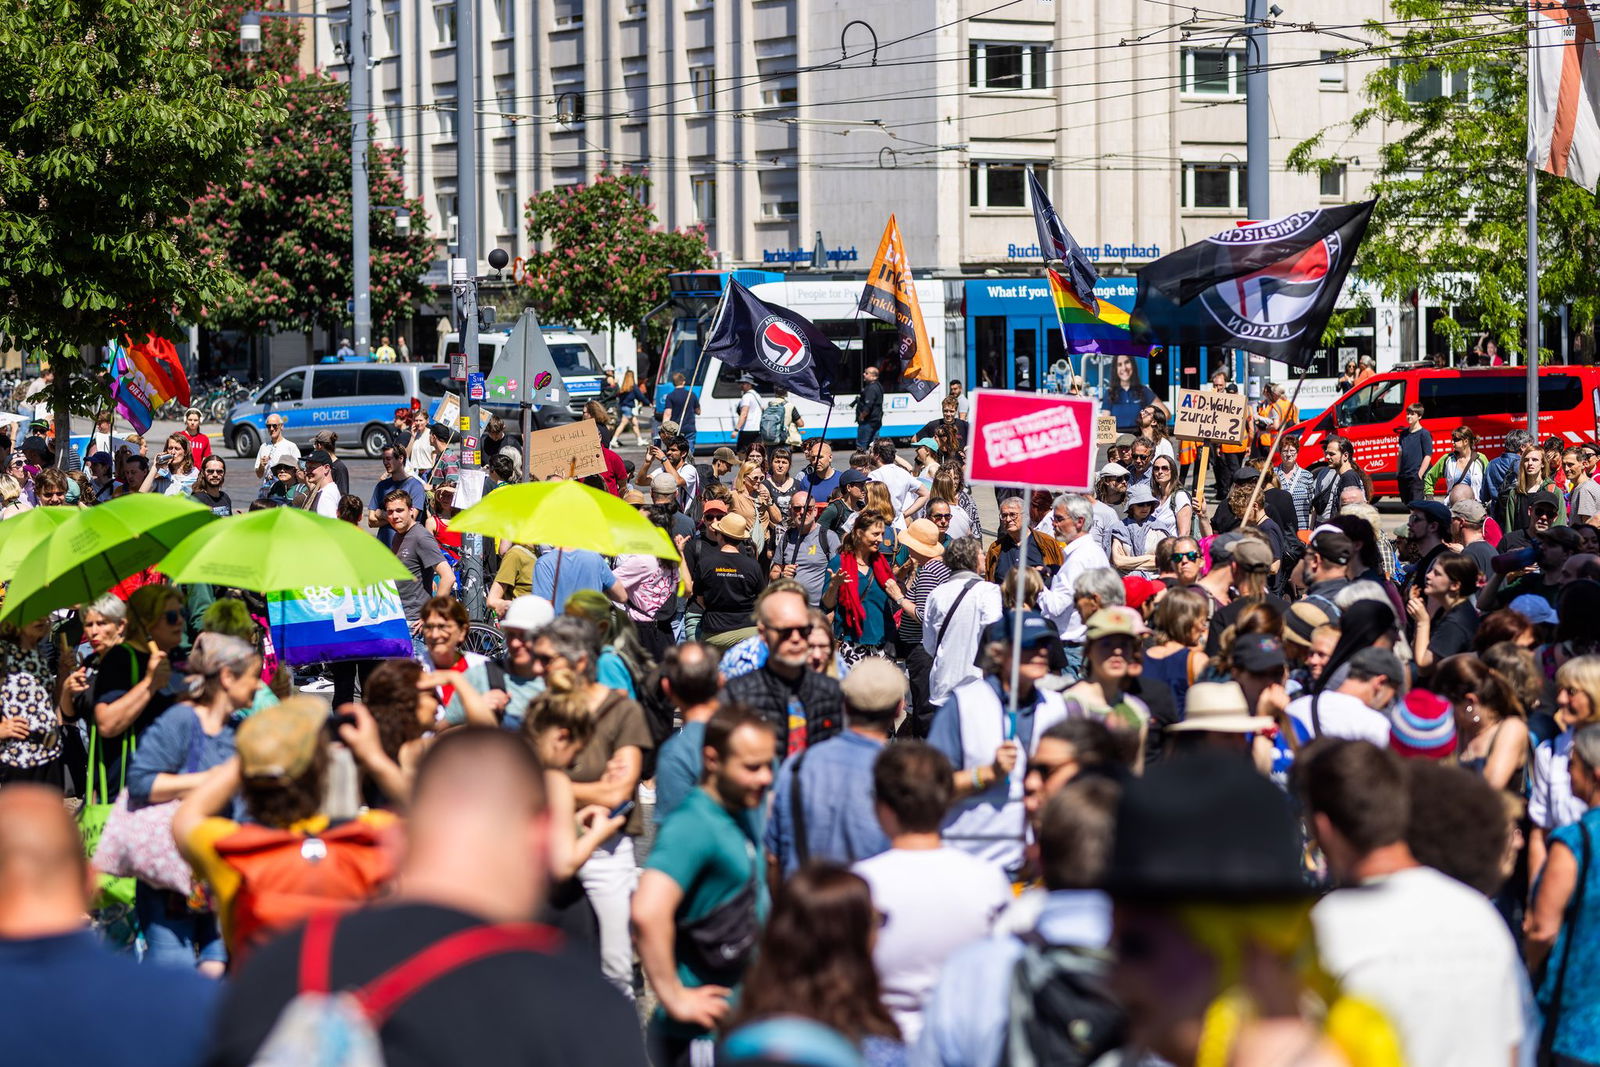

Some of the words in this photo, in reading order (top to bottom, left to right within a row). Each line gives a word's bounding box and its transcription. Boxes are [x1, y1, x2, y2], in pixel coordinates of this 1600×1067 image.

[1104, 243, 1161, 258] Rombach
[987, 286, 1018, 298] What
[1018, 286, 1028, 297] if
[1029, 287, 1048, 300] you
[1117, 284, 1135, 296] the
[763, 358, 790, 373] AKTION
[128, 384, 140, 396] DIE
[312, 410, 349, 422] POLIZEI
[1369, 459, 1384, 468] VAG
